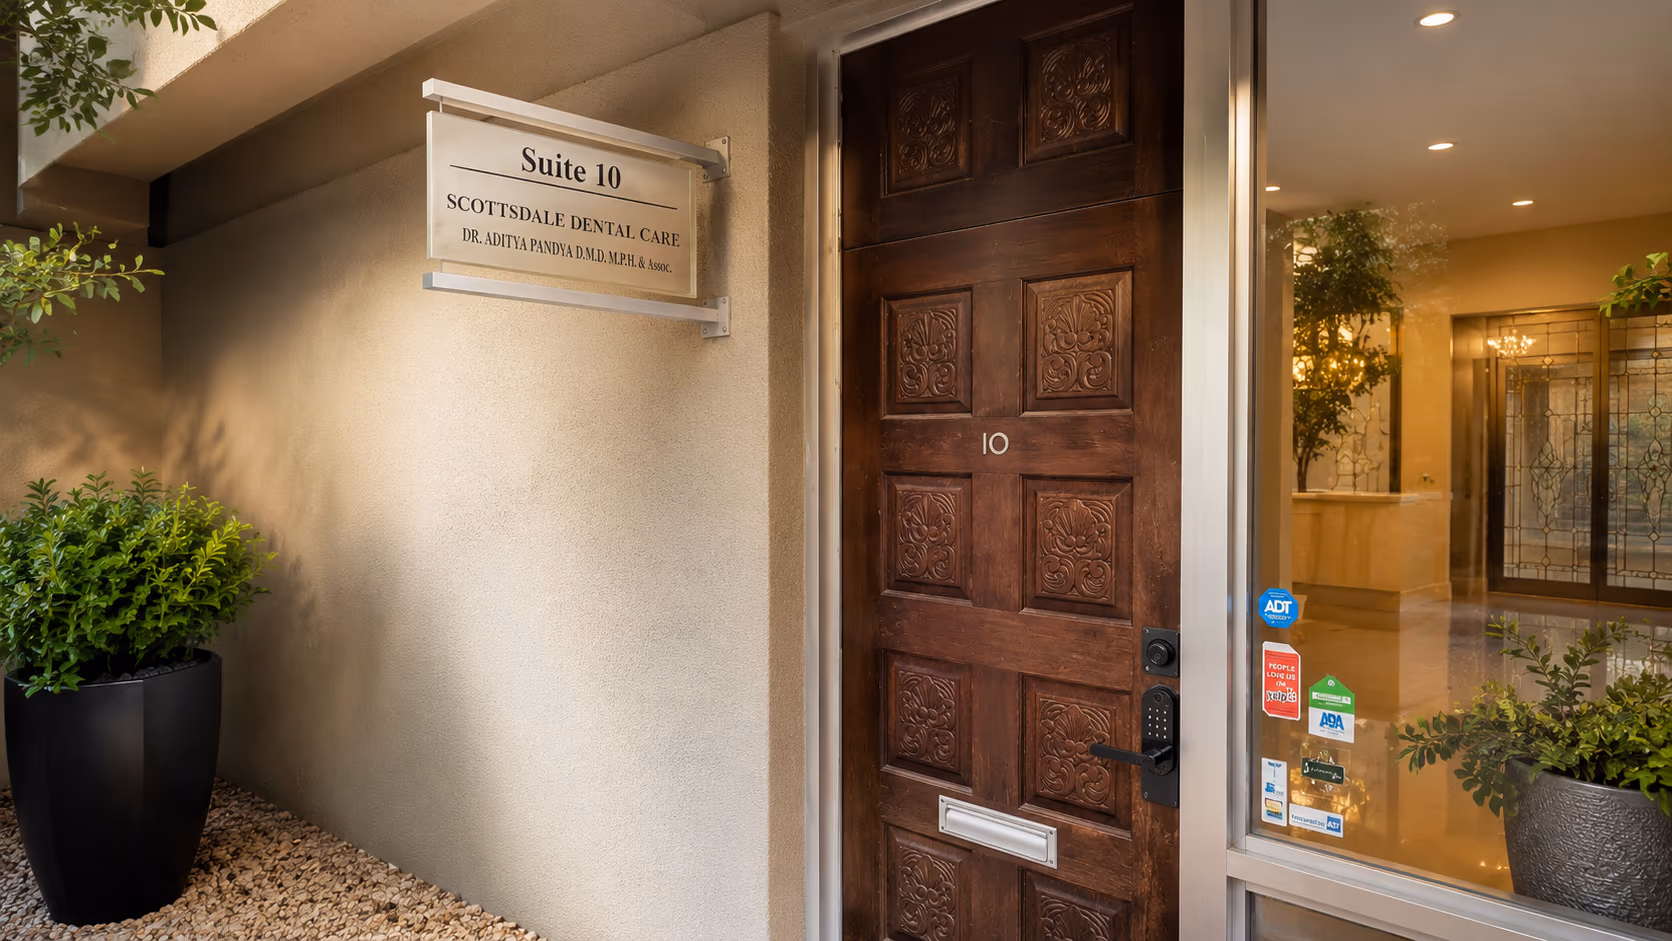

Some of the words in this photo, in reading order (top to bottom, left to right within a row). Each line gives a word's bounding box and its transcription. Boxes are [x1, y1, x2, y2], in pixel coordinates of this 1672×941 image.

[521, 146, 587, 183] Suite
[596, 163, 622, 190] 10
[446, 193, 566, 228] SCOTTSDALE
[570, 215, 636, 240] DENTAL
[639, 227, 680, 248] CARE
[462, 227, 482, 244] DR.
[484, 231, 528, 251] ADITYA
[530, 238, 574, 259] PANDYA
[576, 245, 607, 264] D.M.D.
[608, 250, 637, 268] M.P.H.
[638, 256, 646, 270] &
[982, 431, 1009, 455] 10
[1264, 600, 1292, 614] ADT
